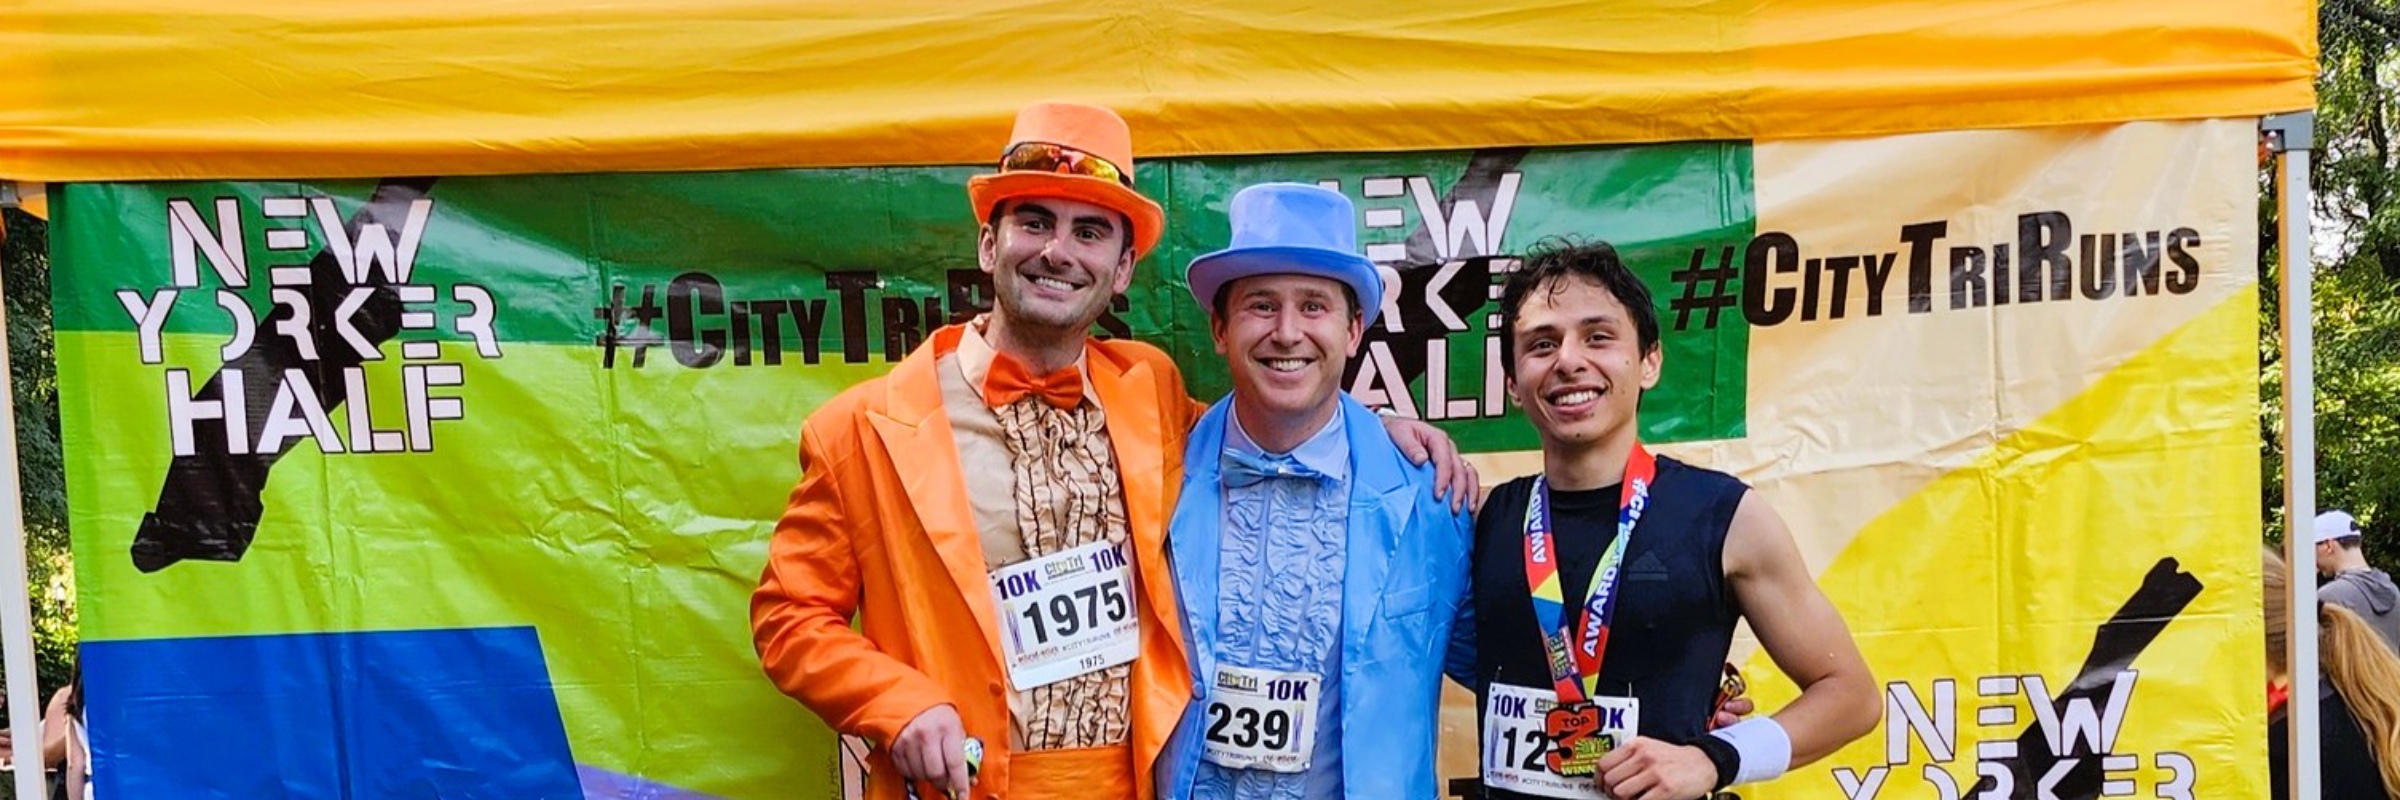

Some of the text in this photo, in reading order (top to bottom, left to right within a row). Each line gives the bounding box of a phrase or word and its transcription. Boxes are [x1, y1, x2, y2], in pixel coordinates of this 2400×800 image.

[167, 197, 433, 287] NEW
[1317, 172, 1523, 261] EW
[117, 285, 502, 364] YORKER
[165, 363, 464, 455] HALF
[1530, 493, 1547, 562] AWARD
[996, 569, 1042, 600] 10K
[1090, 544, 1127, 573] 10K
[1022, 579, 1126, 644] 1975
[1583, 566, 1618, 657] AWARD
[1080, 654, 1105, 670] 1975
[1266, 679, 1309, 701] 10K
[1206, 702, 1290, 751] 239
[1493, 694, 1527, 719] 10K
[1562, 716, 1589, 728] TOP
[1886, 669, 2139, 765] NEW
[1503, 727, 1548, 772] 12
[1561, 763, 1597, 776] WINN
